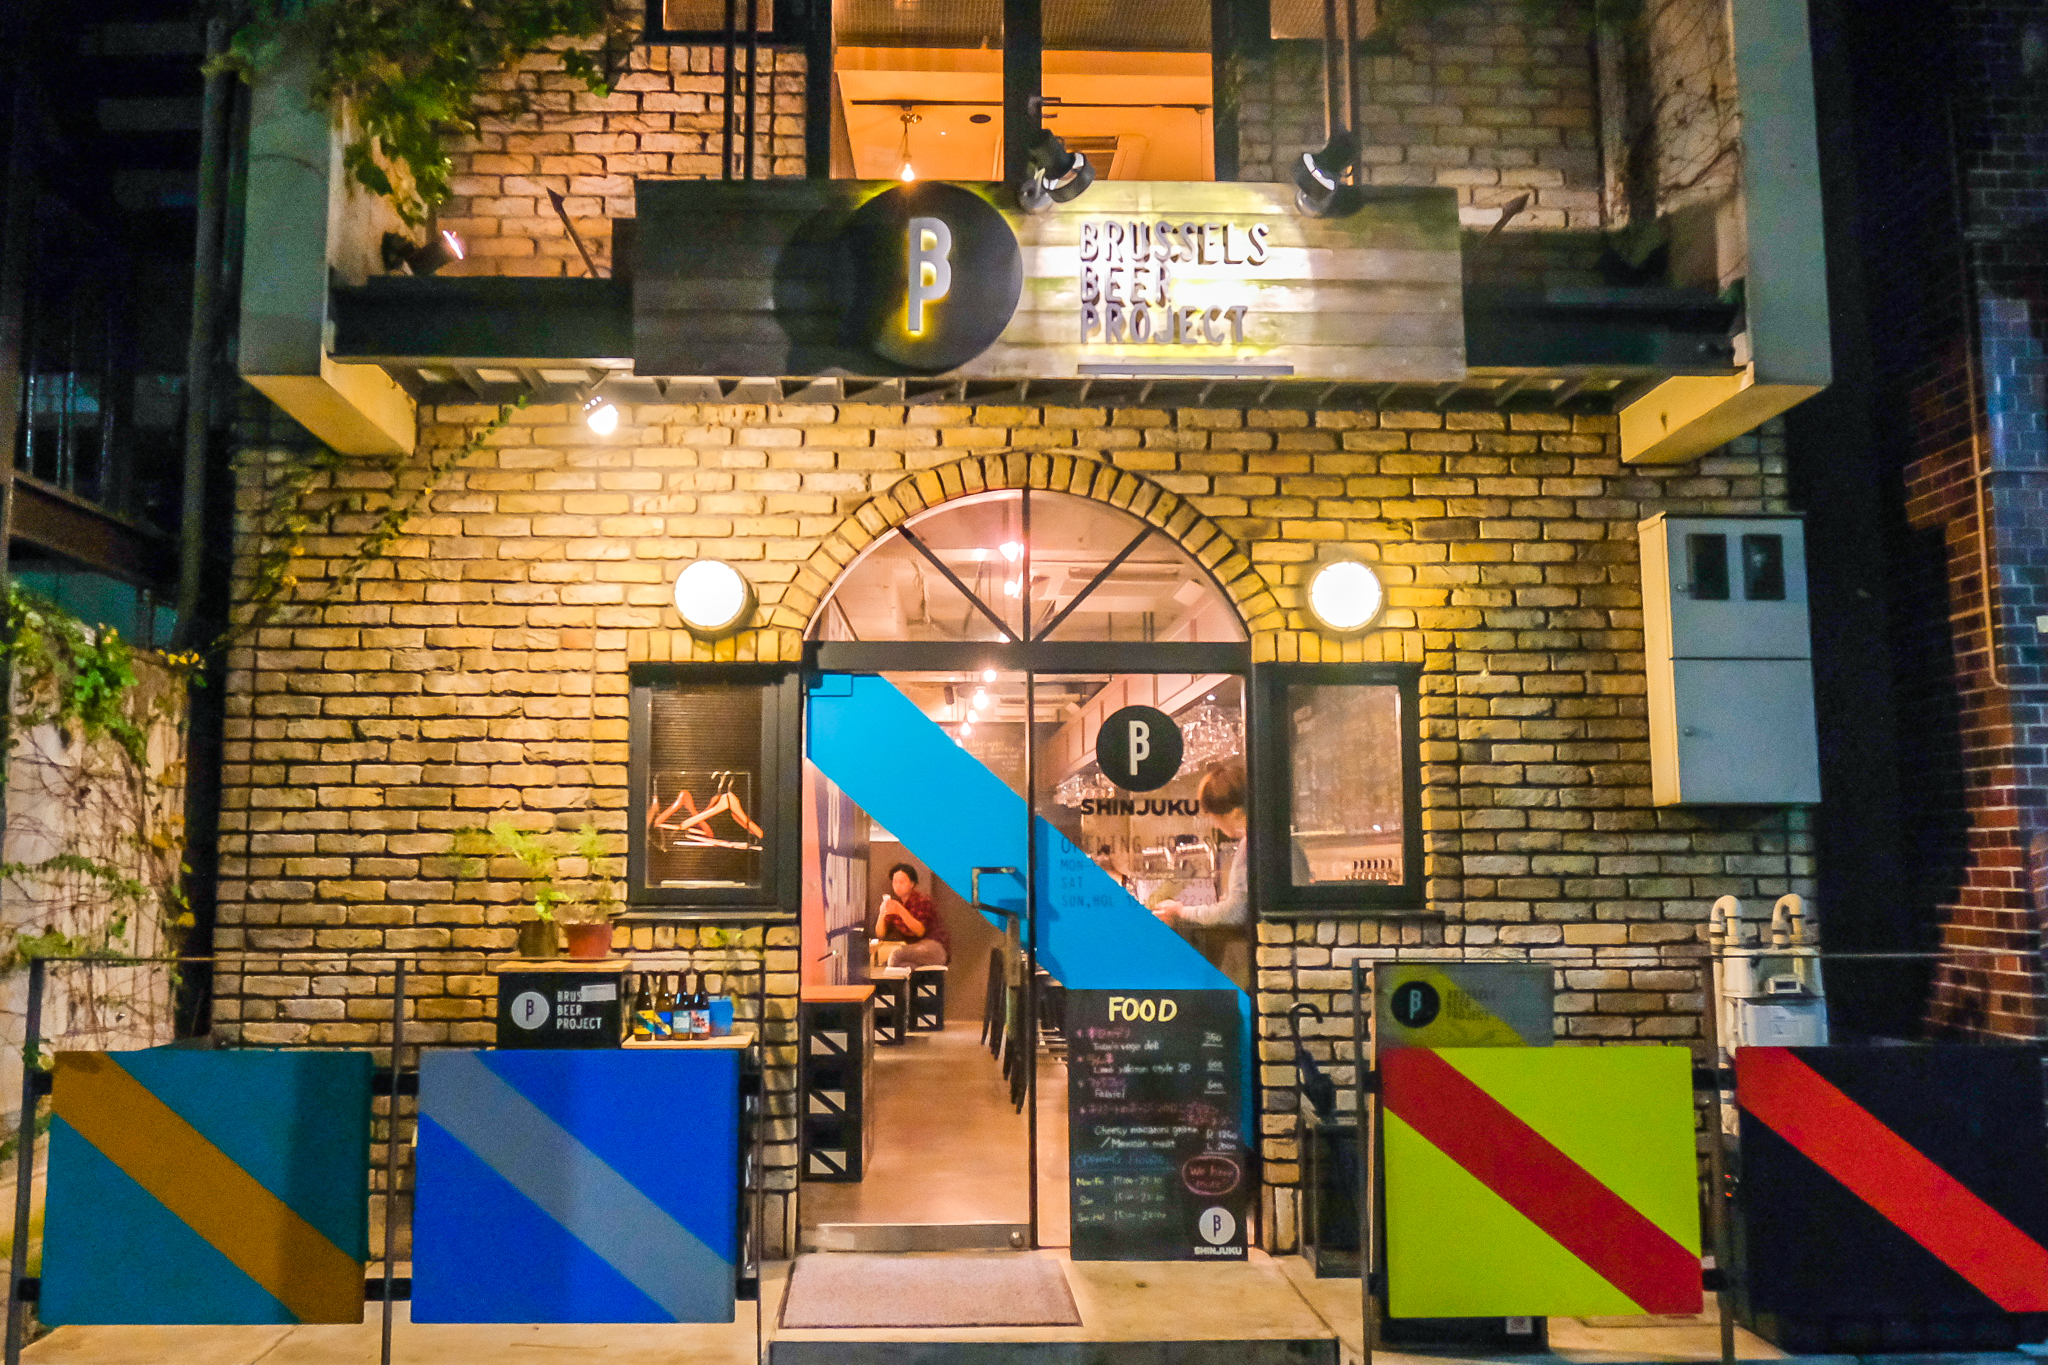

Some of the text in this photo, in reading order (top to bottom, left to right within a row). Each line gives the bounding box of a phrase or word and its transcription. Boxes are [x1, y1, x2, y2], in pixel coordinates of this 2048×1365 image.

[1080, 221, 1270, 266] BRUSSELS
[1081, 263, 1172, 307] BEER
[1081, 304, 1248, 344] PROJECT
[1081, 798, 1200, 816] SHINJUKU
[557, 1004, 583, 1016] BEER
[1108, 996, 1178, 1022] FOOD
[557, 1017, 602, 1029] PROJECT
